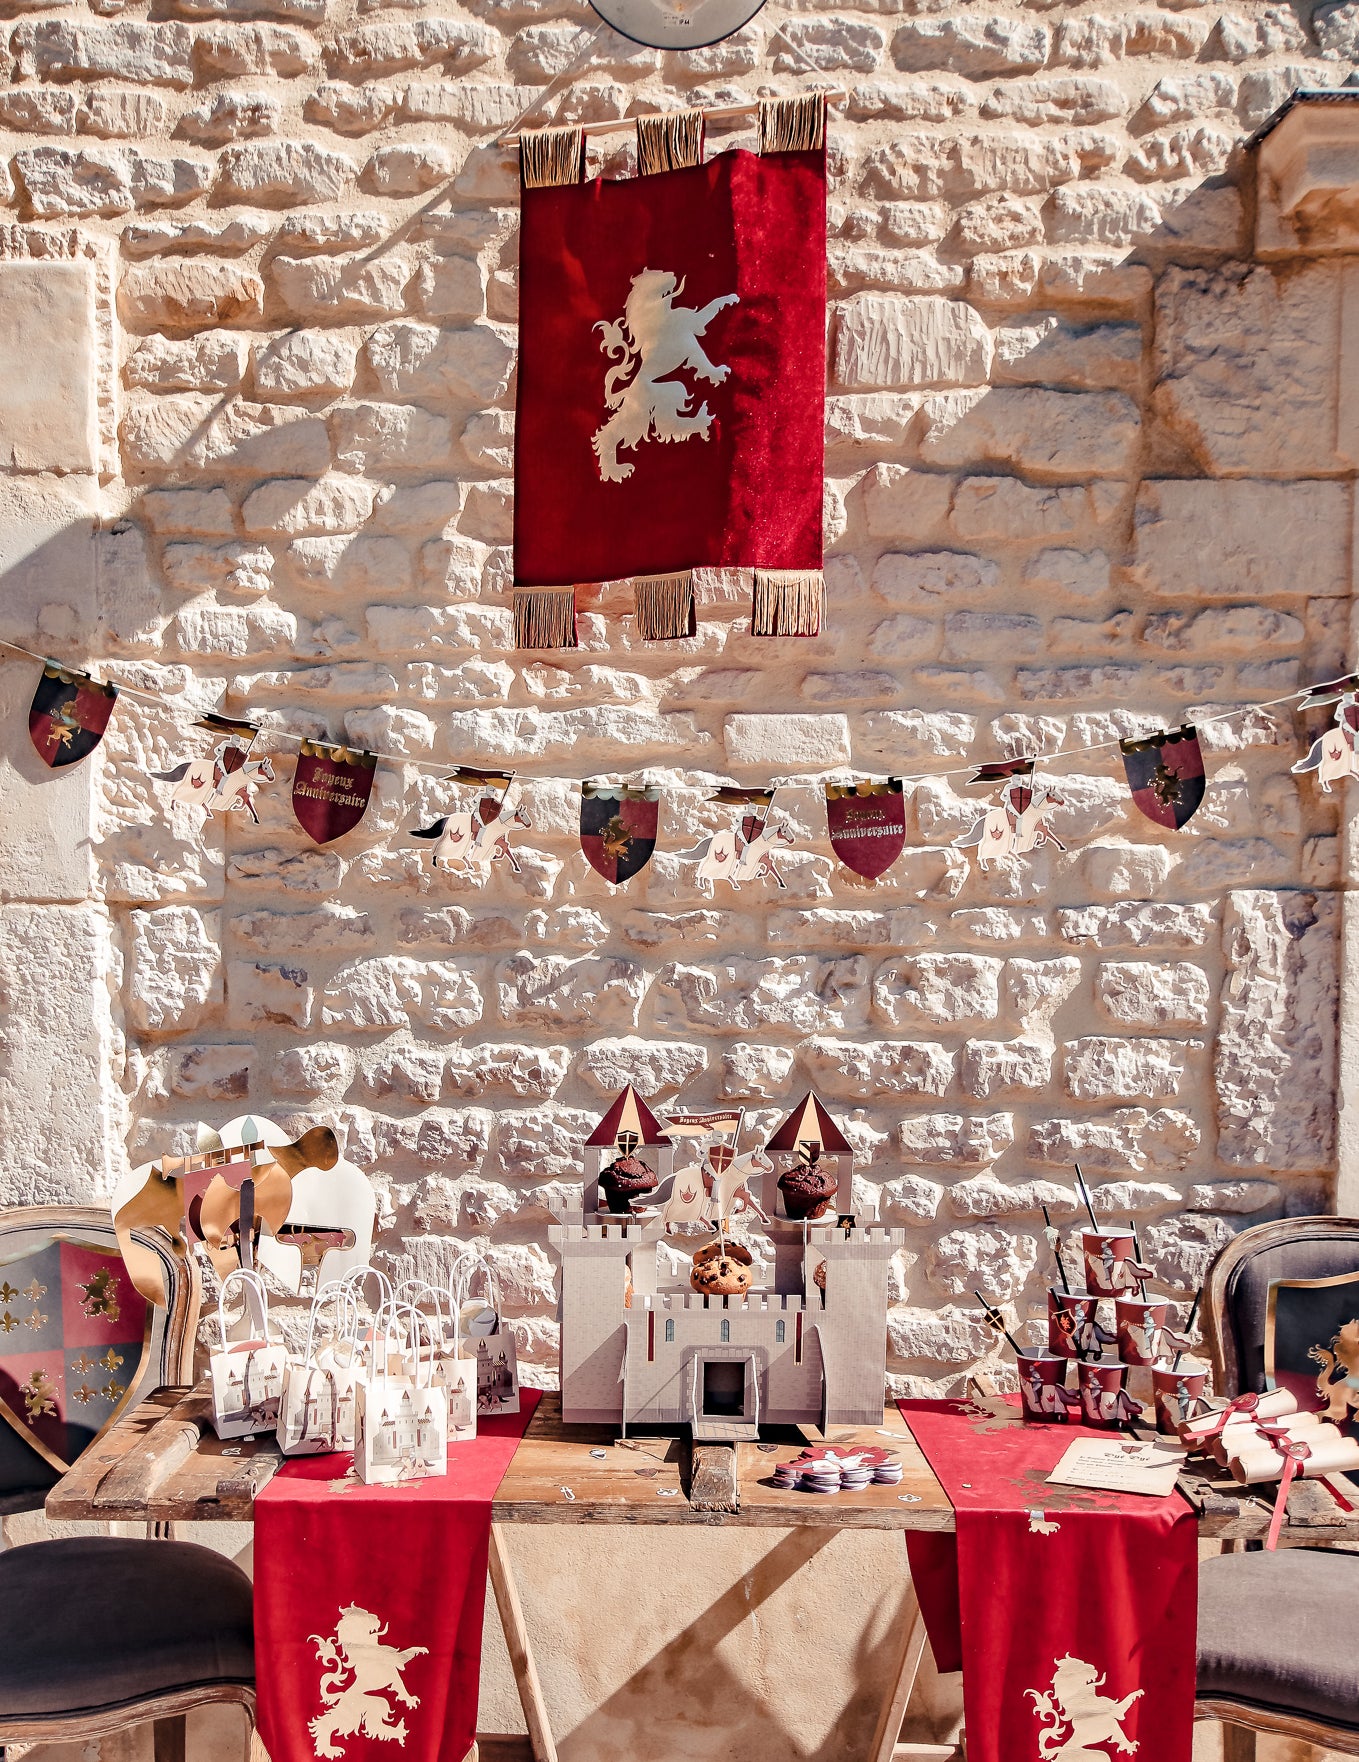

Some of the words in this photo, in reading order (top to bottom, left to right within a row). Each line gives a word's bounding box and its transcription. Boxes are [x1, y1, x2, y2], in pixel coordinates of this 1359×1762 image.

[312, 767, 355, 789] Joyeux
[293, 781, 366, 808] Anniversaire
[831, 822, 904, 841] Anniversaire
[678, 1116, 699, 1124] Joyeux
[699, 1113, 733, 1124] Anniversaire
